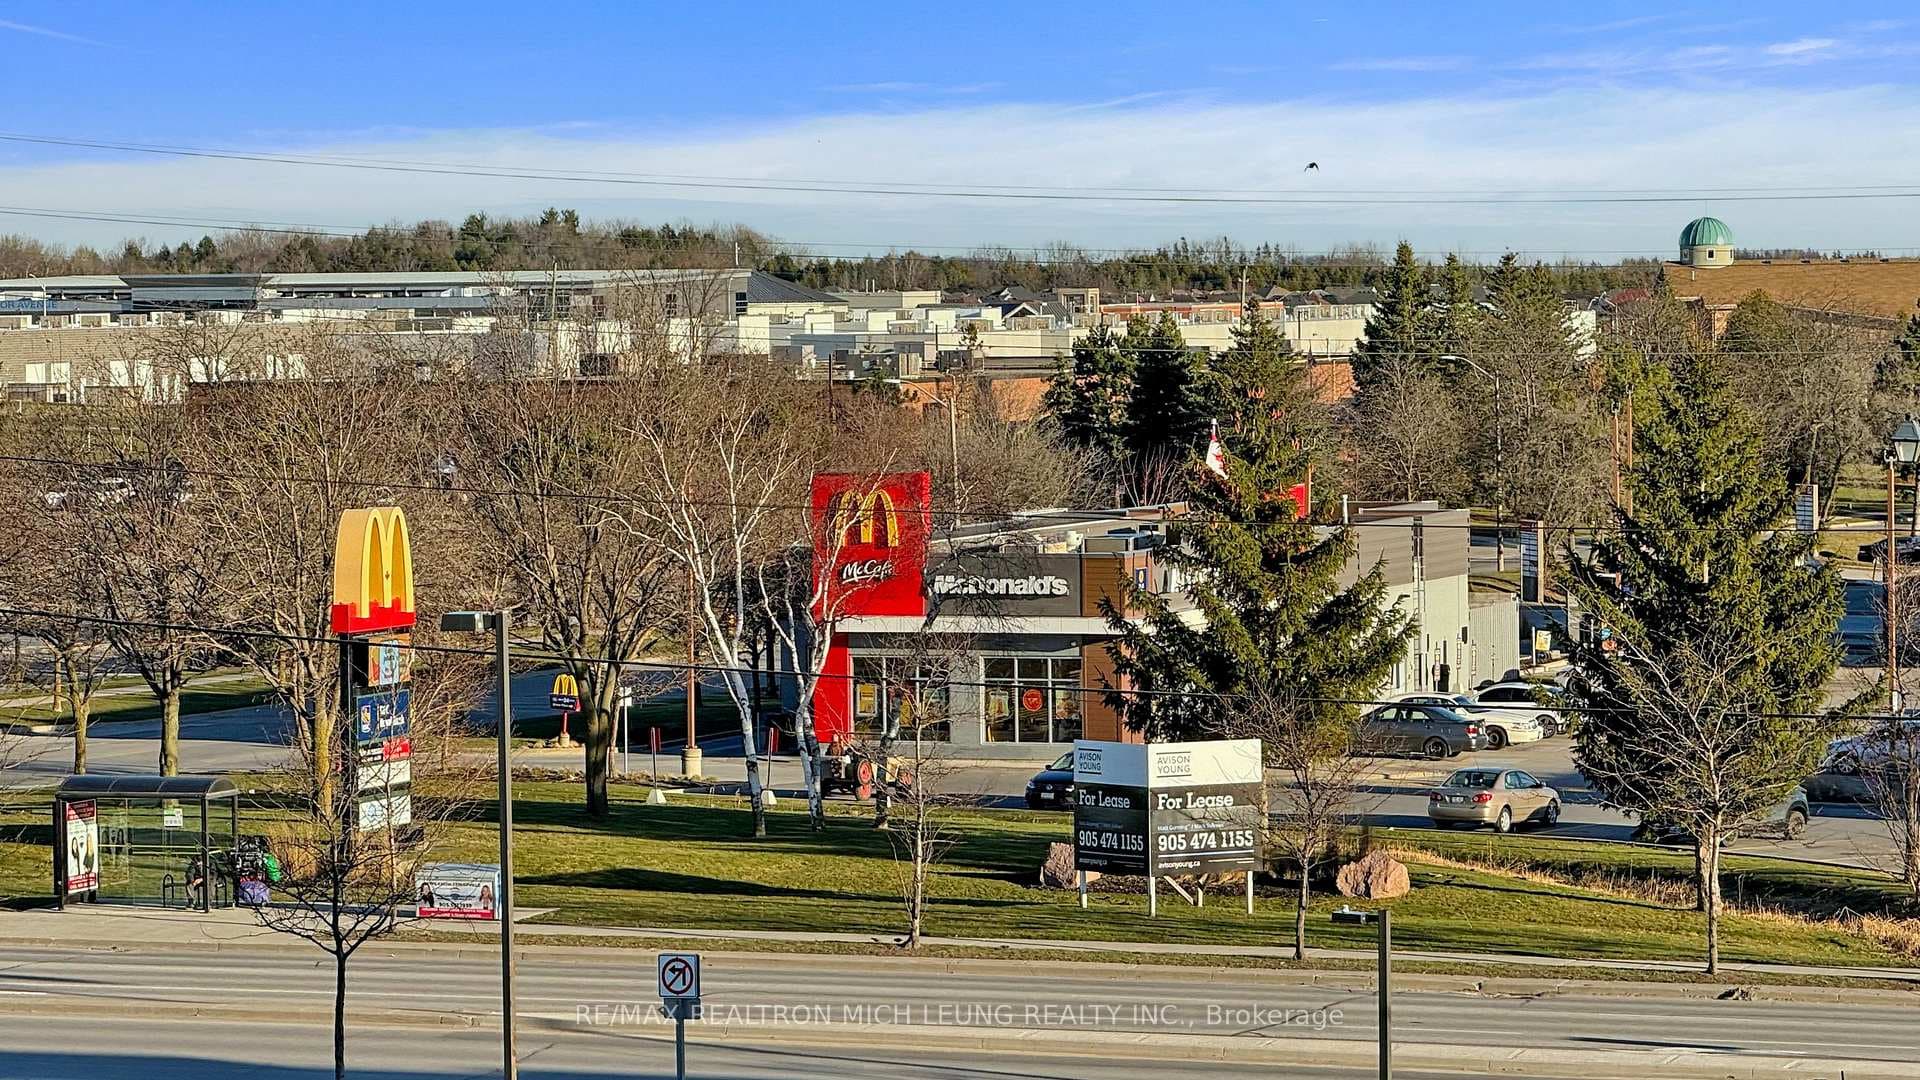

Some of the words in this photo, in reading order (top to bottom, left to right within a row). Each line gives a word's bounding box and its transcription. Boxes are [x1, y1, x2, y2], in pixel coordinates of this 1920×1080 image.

[933, 575, 1068, 596] McDonald's
[1078, 752, 1102, 762] AVISON
[1079, 761, 1102, 771] YOUNG
[1157, 755, 1191, 765] AVISON
[1157, 764, 1191, 774] YOUNG
[1078, 789, 1097, 806] For
[1098, 790, 1131, 809] Lease
[1157, 793, 1183, 810] For
[1185, 791, 1234, 809] Lease
[1079, 830, 1098, 847] 905
[1100, 831, 1118, 849] 474
[1120, 833, 1144, 851] 1155
[1158, 833, 1187, 851] 905
[1189, 832, 1217, 850] 474
[1220, 830, 1254, 848] 1155
